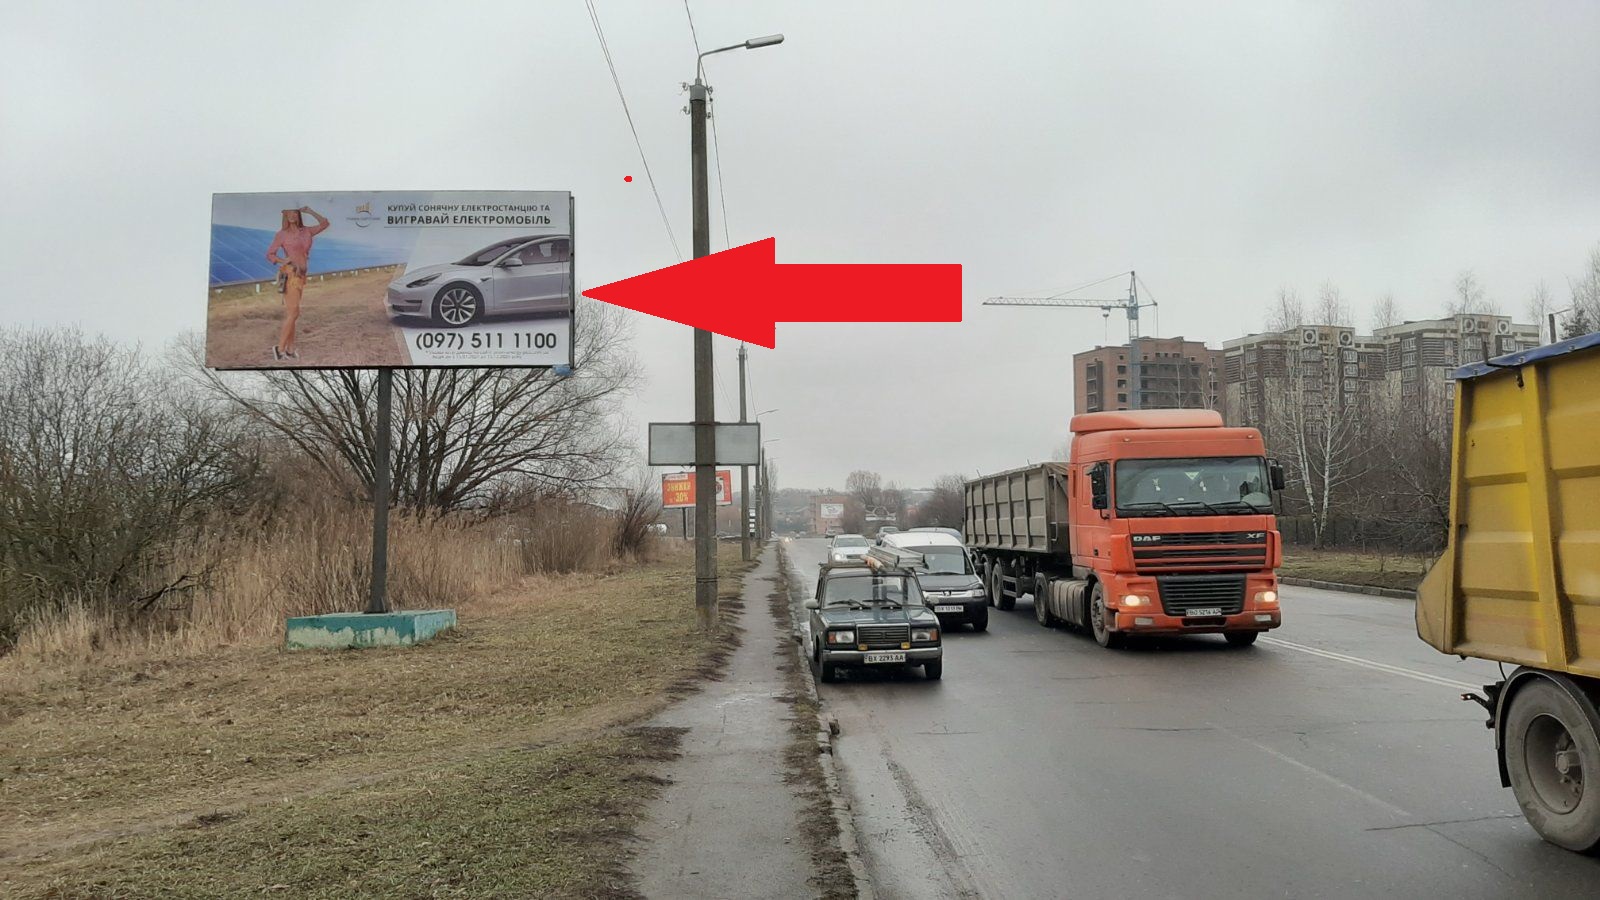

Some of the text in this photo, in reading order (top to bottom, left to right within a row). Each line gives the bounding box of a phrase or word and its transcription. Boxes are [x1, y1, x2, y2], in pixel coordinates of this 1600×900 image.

[387, 203, 416, 212] КУПУЙ
[418, 204, 459, 212] СОНЯЧНУ
[461, 204, 538, 213] ЕЛЕКТРОСТАНЦІЮ
[387, 213, 551, 225] ВИГРАВАЙ ЕЛЕКТРОМОБІЛЬ
[416, 332, 557, 350] (097) 511 1100
